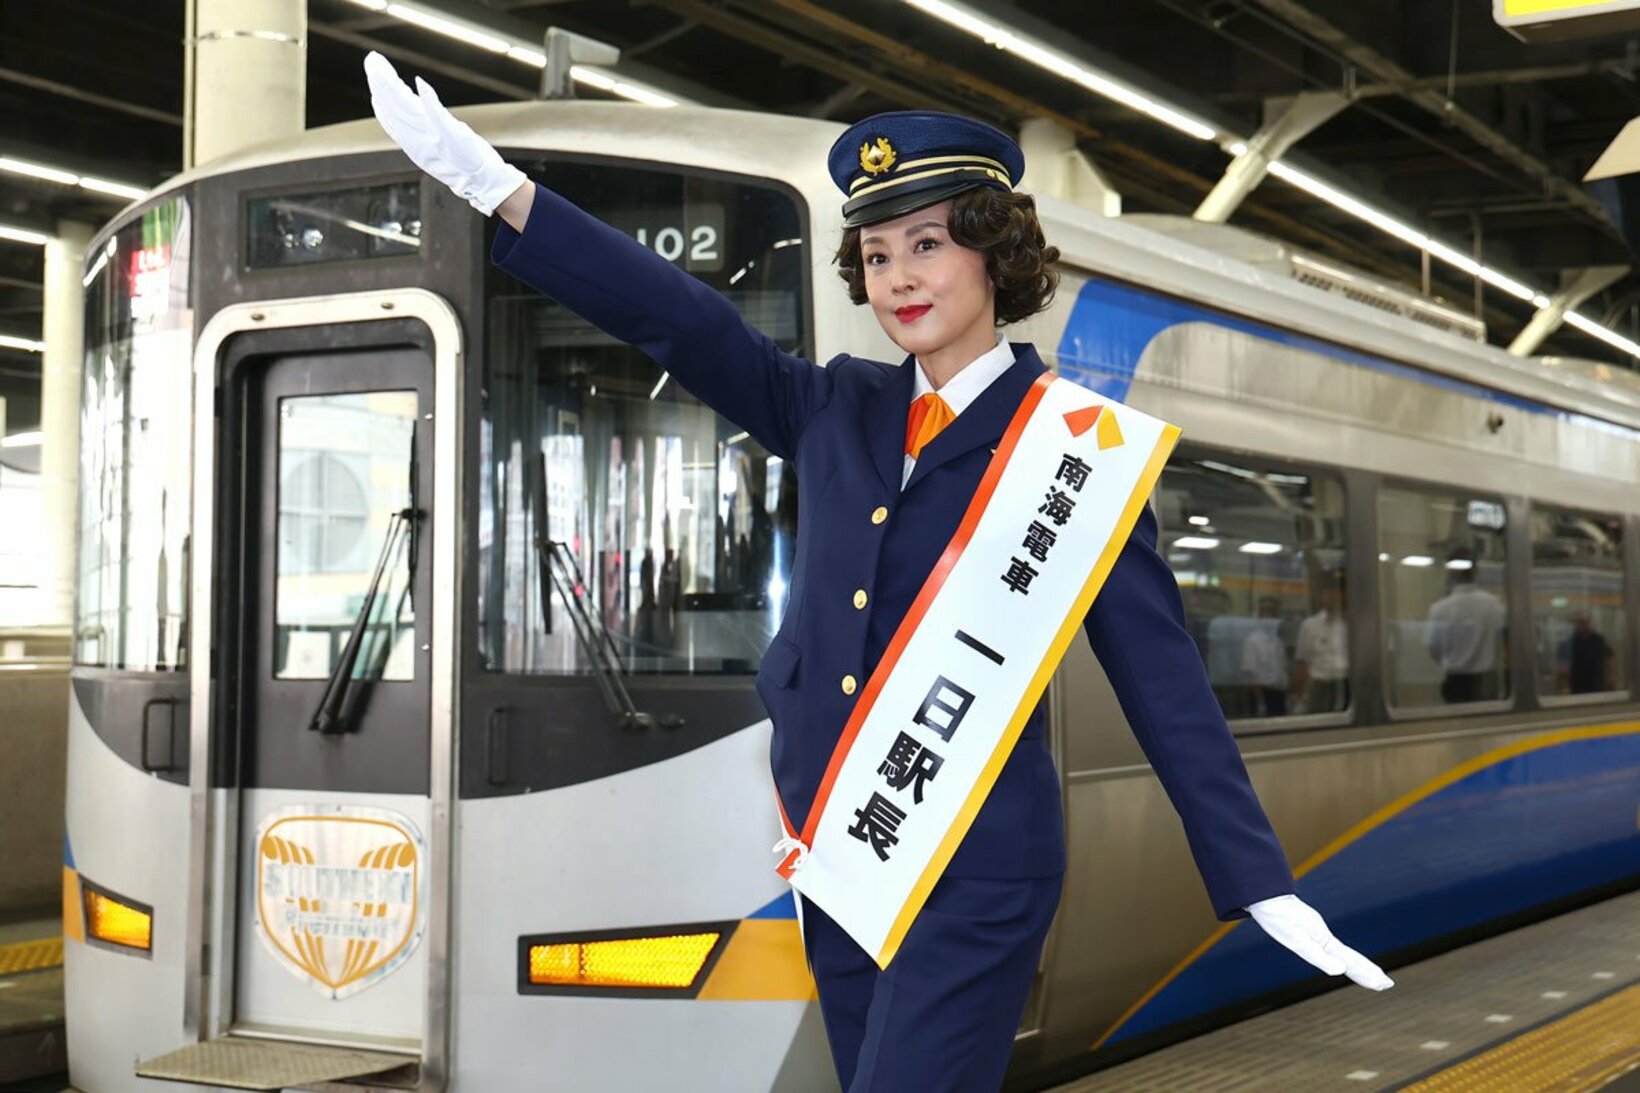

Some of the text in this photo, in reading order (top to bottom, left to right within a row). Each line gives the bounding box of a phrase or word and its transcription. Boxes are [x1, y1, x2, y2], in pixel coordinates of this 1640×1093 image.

[847, 453, 1093, 862] 南海電車 一日駅長
